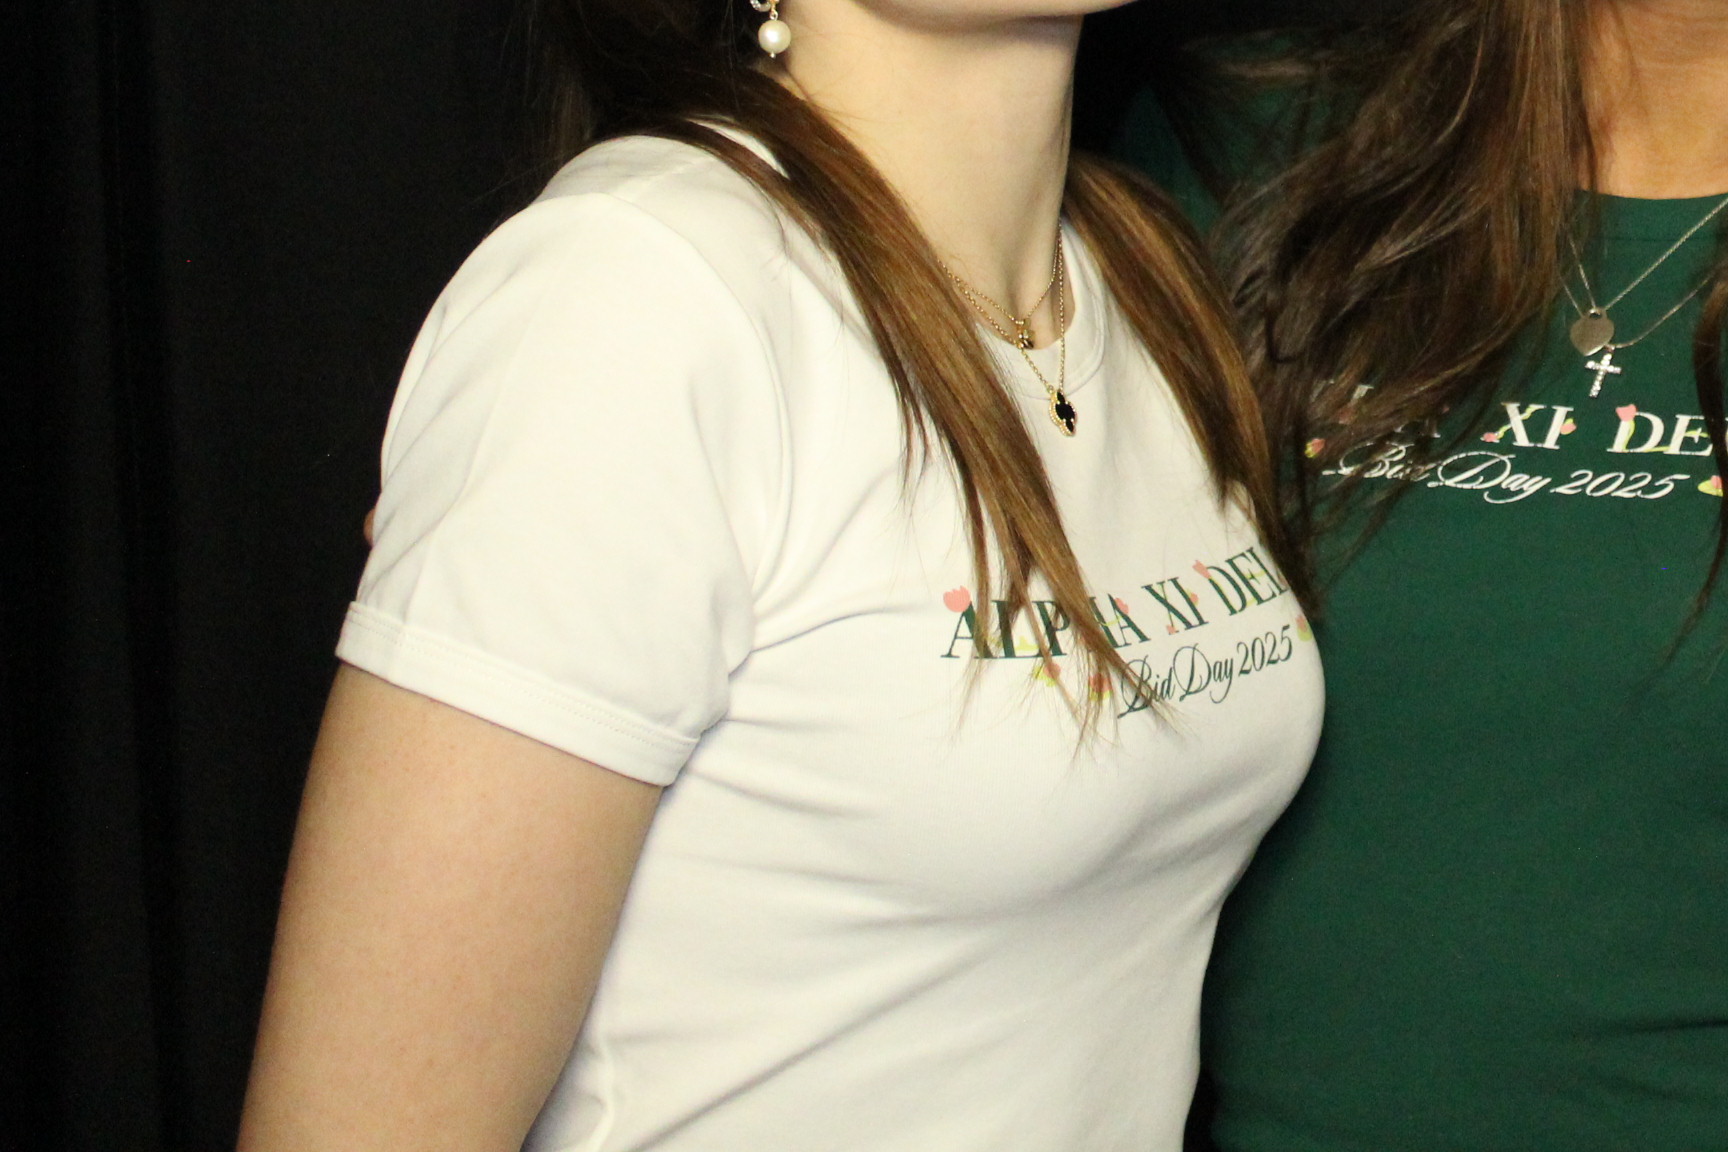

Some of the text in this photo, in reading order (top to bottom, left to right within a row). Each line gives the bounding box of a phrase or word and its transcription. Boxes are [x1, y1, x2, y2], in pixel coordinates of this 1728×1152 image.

[1481, 402, 1576, 450] XI
[1427, 450, 1552, 504] Day
[1550, 470, 1691, 499] 2025
[1141, 576, 1210, 635] XI
[1117, 624, 1292, 719] Bid Day 2025
